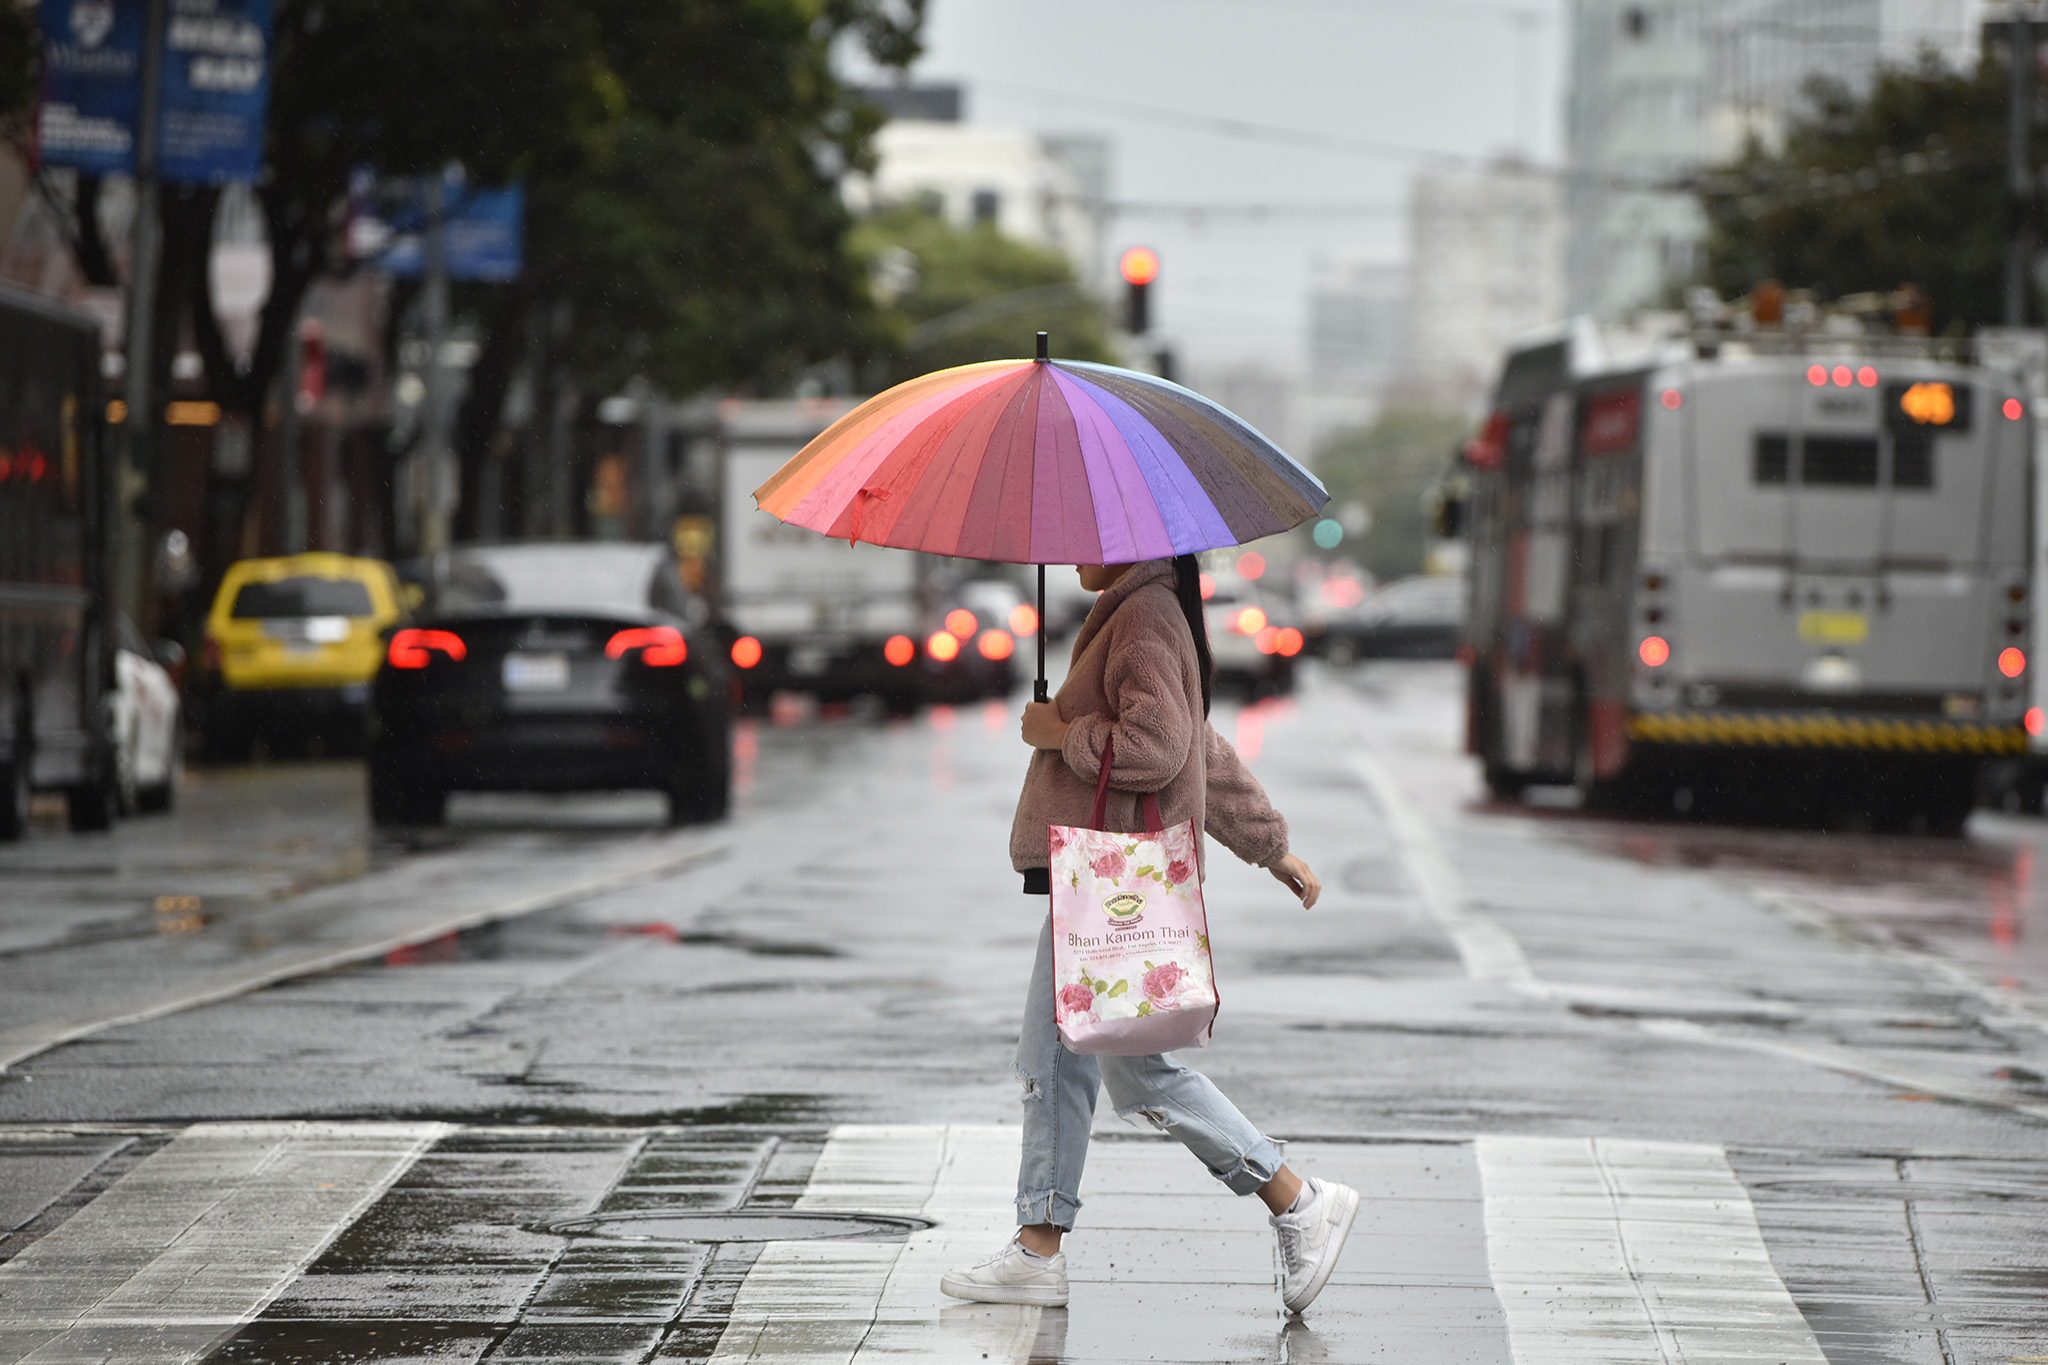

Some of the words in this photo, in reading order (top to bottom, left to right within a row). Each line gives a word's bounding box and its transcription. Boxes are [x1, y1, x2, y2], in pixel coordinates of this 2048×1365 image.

[1068, 932, 1100, 947] Bhan
[1105, 930, 1155, 945] Kanom
[1160, 926, 1189, 939] Thai
